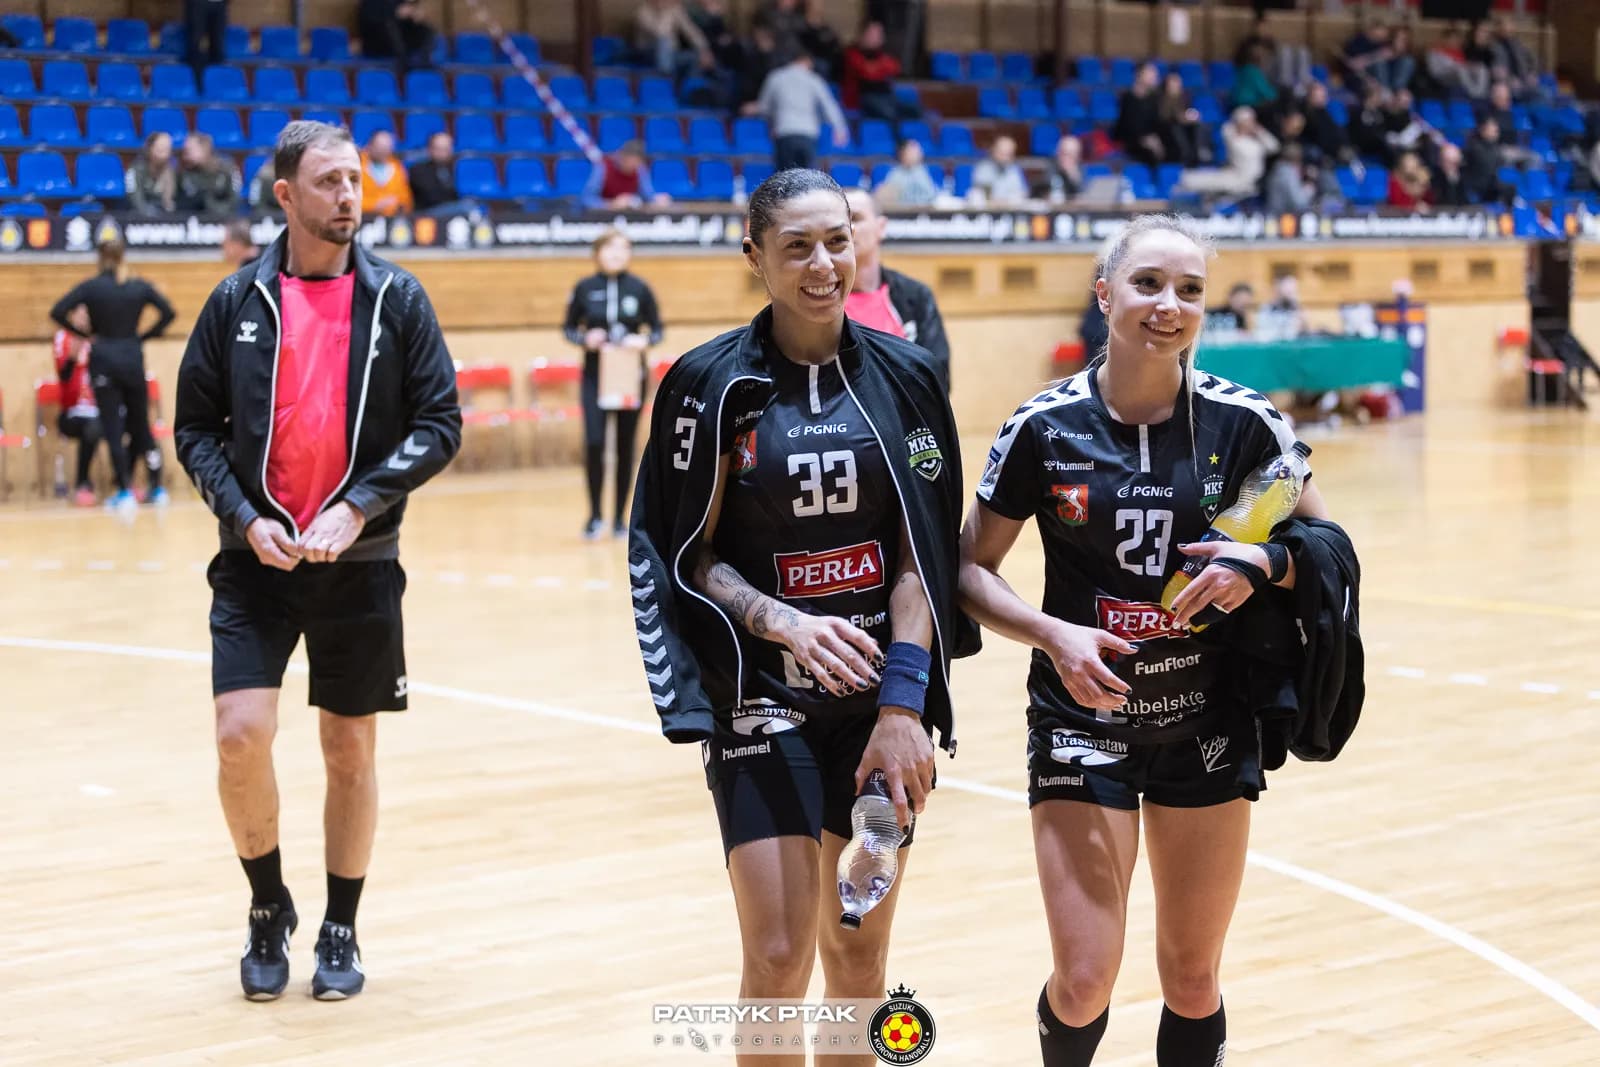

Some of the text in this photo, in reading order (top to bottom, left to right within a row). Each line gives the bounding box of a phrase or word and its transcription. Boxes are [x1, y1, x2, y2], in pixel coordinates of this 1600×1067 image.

[803, 423, 848, 436] PGNiG
[1060, 431, 1094, 441] HUP-BUD
[673, 417, 697, 471] 3
[907, 434, 938, 456] MKS
[1056, 460, 1095, 471] hummel
[787, 449, 859, 518] 33
[1132, 485, 1174, 498] PGNiG
[1203, 481, 1224, 497] MKS
[1115, 508, 1174, 577] 23
[787, 552, 877, 588] PERŁA
[849, 610, 887, 628] Floor
[1135, 653, 1202, 675] FunFloor
[722, 740, 771, 761] hummel
[1051, 734, 1129, 753] Krasnystaw
[1037, 773, 1085, 788] hummel
